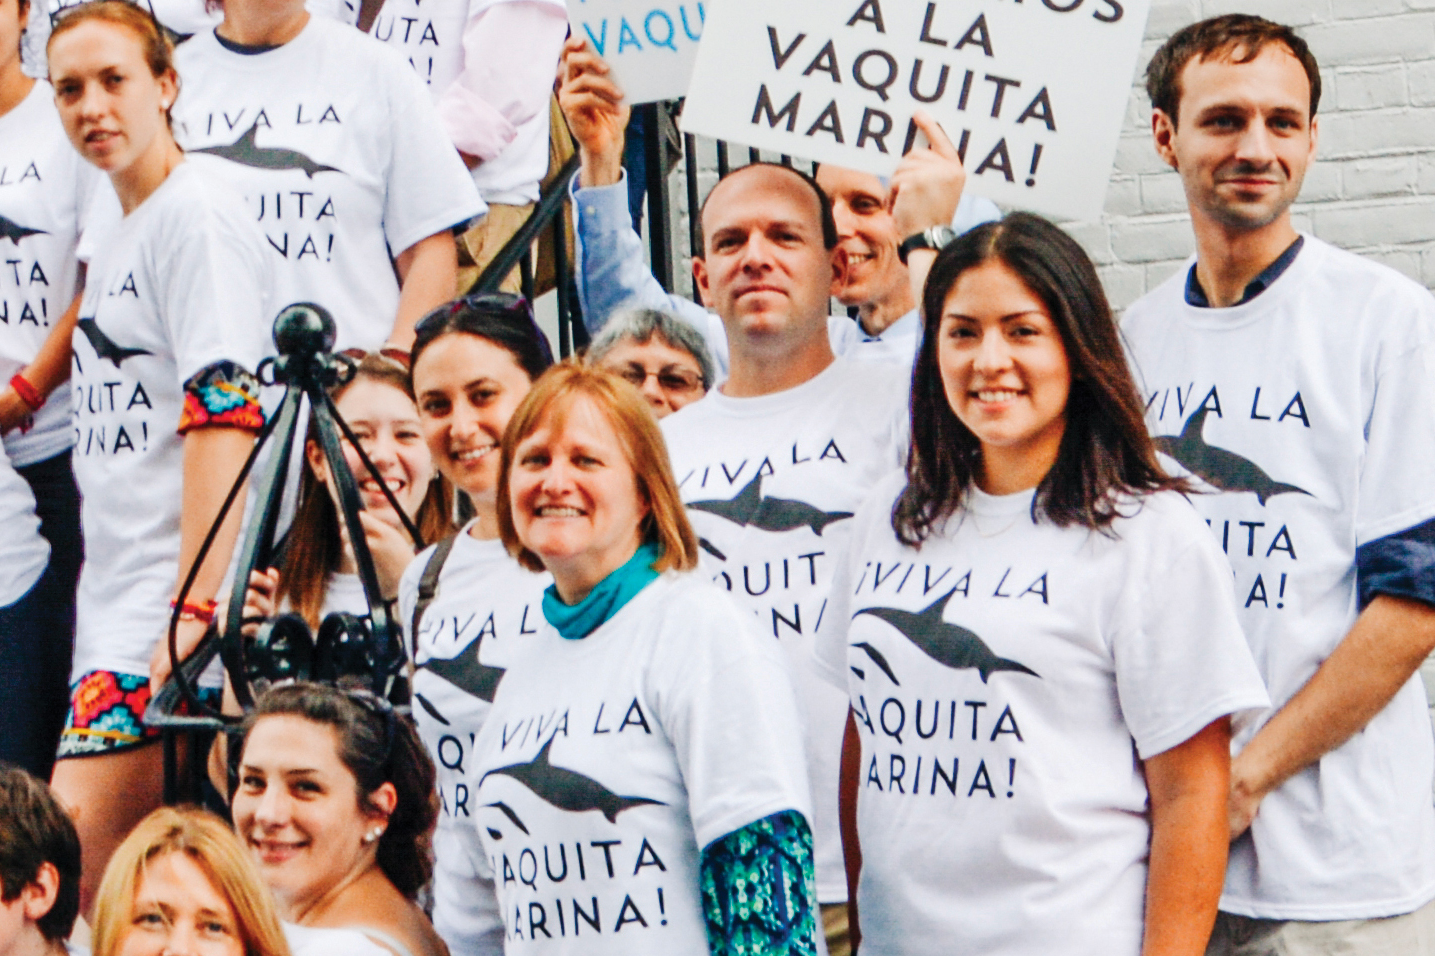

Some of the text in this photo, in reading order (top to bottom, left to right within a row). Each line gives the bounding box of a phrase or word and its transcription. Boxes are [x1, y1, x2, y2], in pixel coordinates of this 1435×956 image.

[583, 2, 706, 57] VAQU
[846, 0, 886, 34] A
[919, 1, 995, 59] LA
[766, 24, 1058, 132] VAQUITA
[207, 103, 342, 136] IVA LA
[751, 83, 1045, 188] MARIA!
[0, 160, 42, 187] LA
[1145, 380, 1311, 429] IVA LA
[680, 437, 848, 488] IVA LA
[855, 561, 1049, 606] ¡VIVA LA
[419, 603, 537, 646] IVA L
[593, 696, 652, 735] LA
[867, 752, 1017, 799] ARINA!
[492, 836, 668, 893] AQUITA
[507, 886, 669, 941] ARINA!
